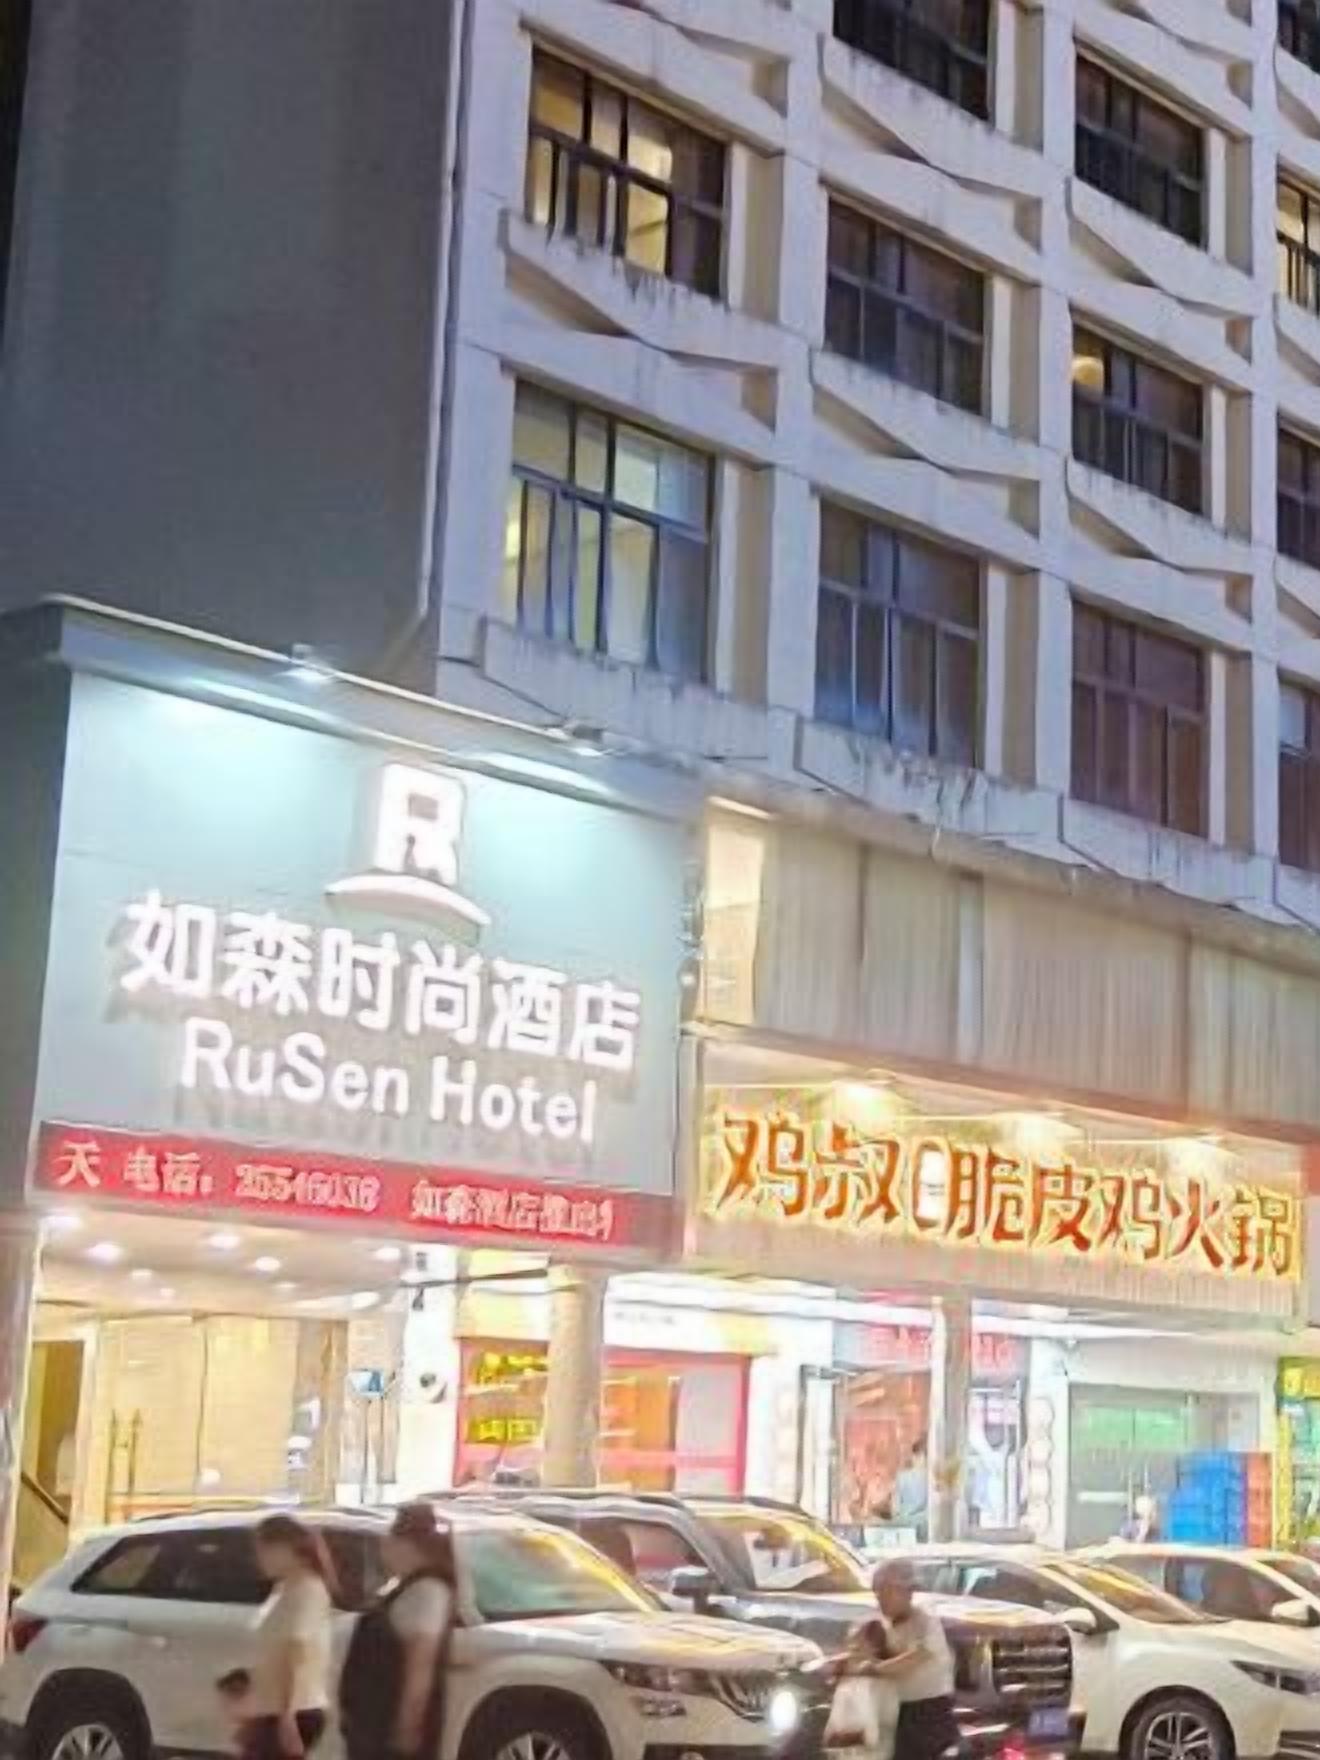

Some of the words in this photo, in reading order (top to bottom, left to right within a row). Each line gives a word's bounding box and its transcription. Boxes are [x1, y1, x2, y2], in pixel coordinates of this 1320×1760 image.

[120, 888, 642, 1072] 如森时尚酒店
[180, 1016, 410, 1116] RuSen
[428, 1055, 599, 1145] Hotel
